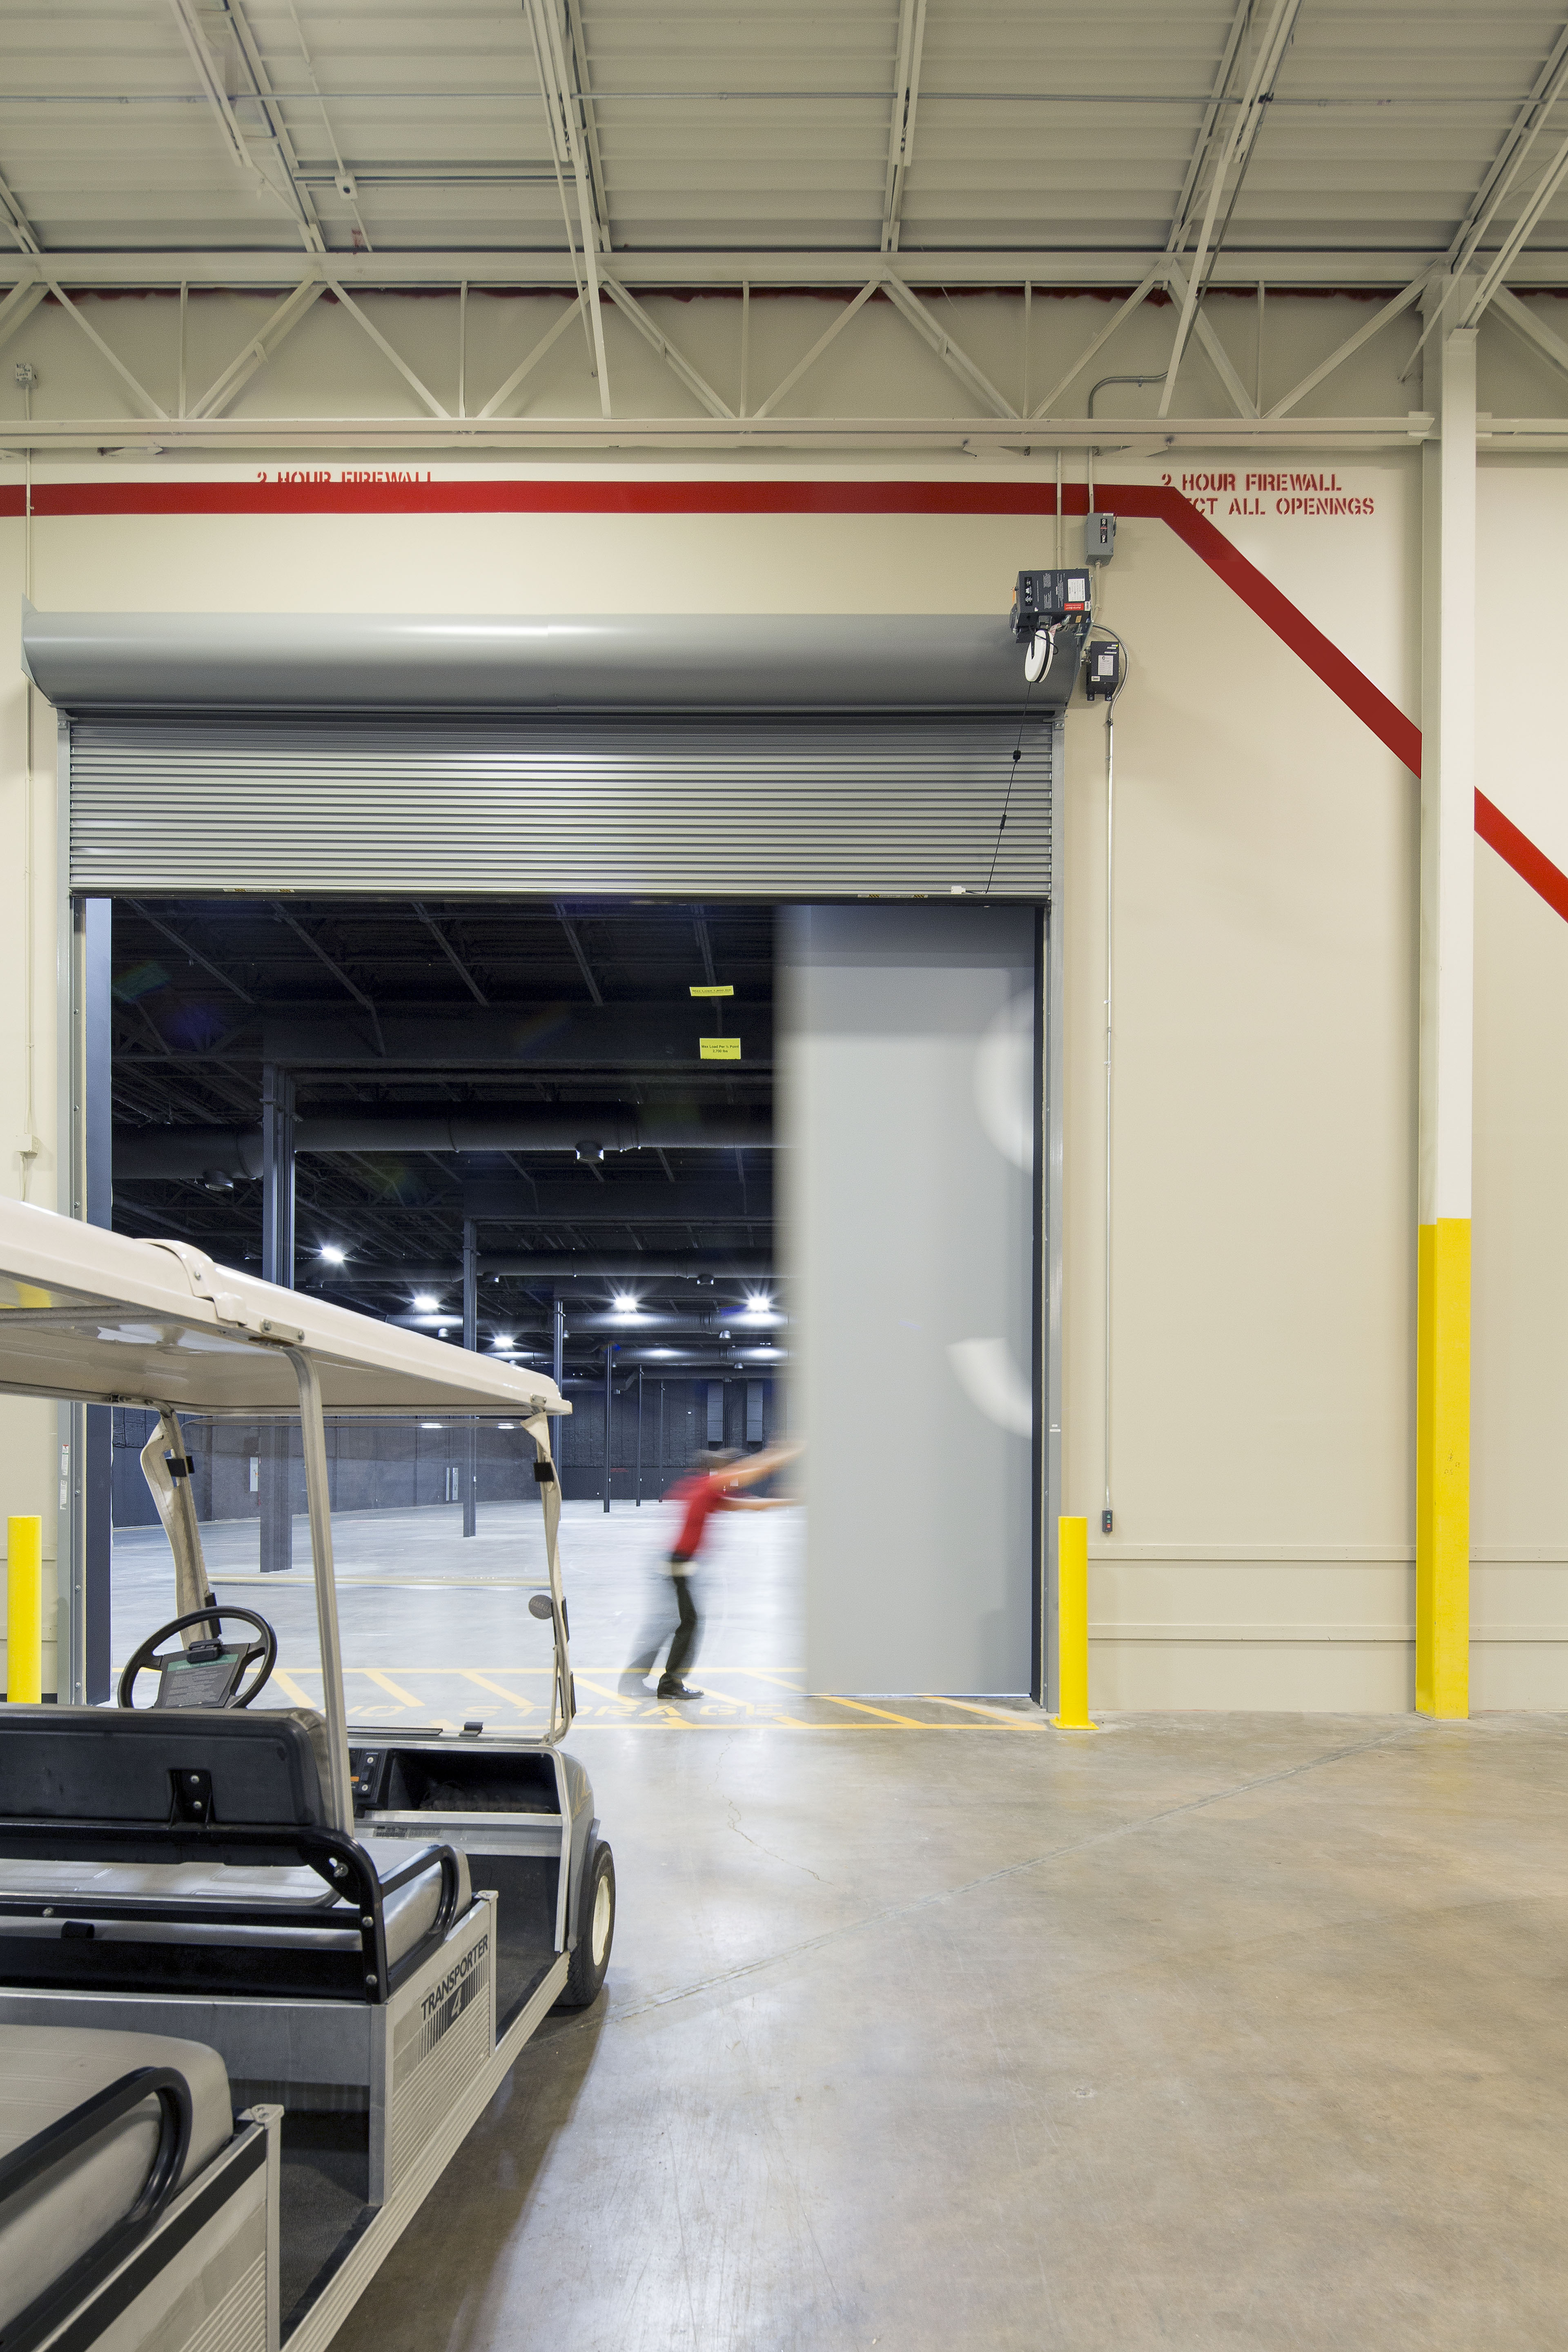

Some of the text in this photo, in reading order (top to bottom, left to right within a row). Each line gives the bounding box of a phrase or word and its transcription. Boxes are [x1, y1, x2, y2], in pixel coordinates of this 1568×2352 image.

[278, 471, 331, 482] HOUR
[1162, 473, 1342, 492] 2 HOUR FIREWALL
[1186, 498, 1374, 515] CT ALL OPENINGS
[459, 1705, 784, 1717] STORAGE
[421, 1934, 488, 2021] TRANSPORTER
[451, 1986, 462, 2018] 4
